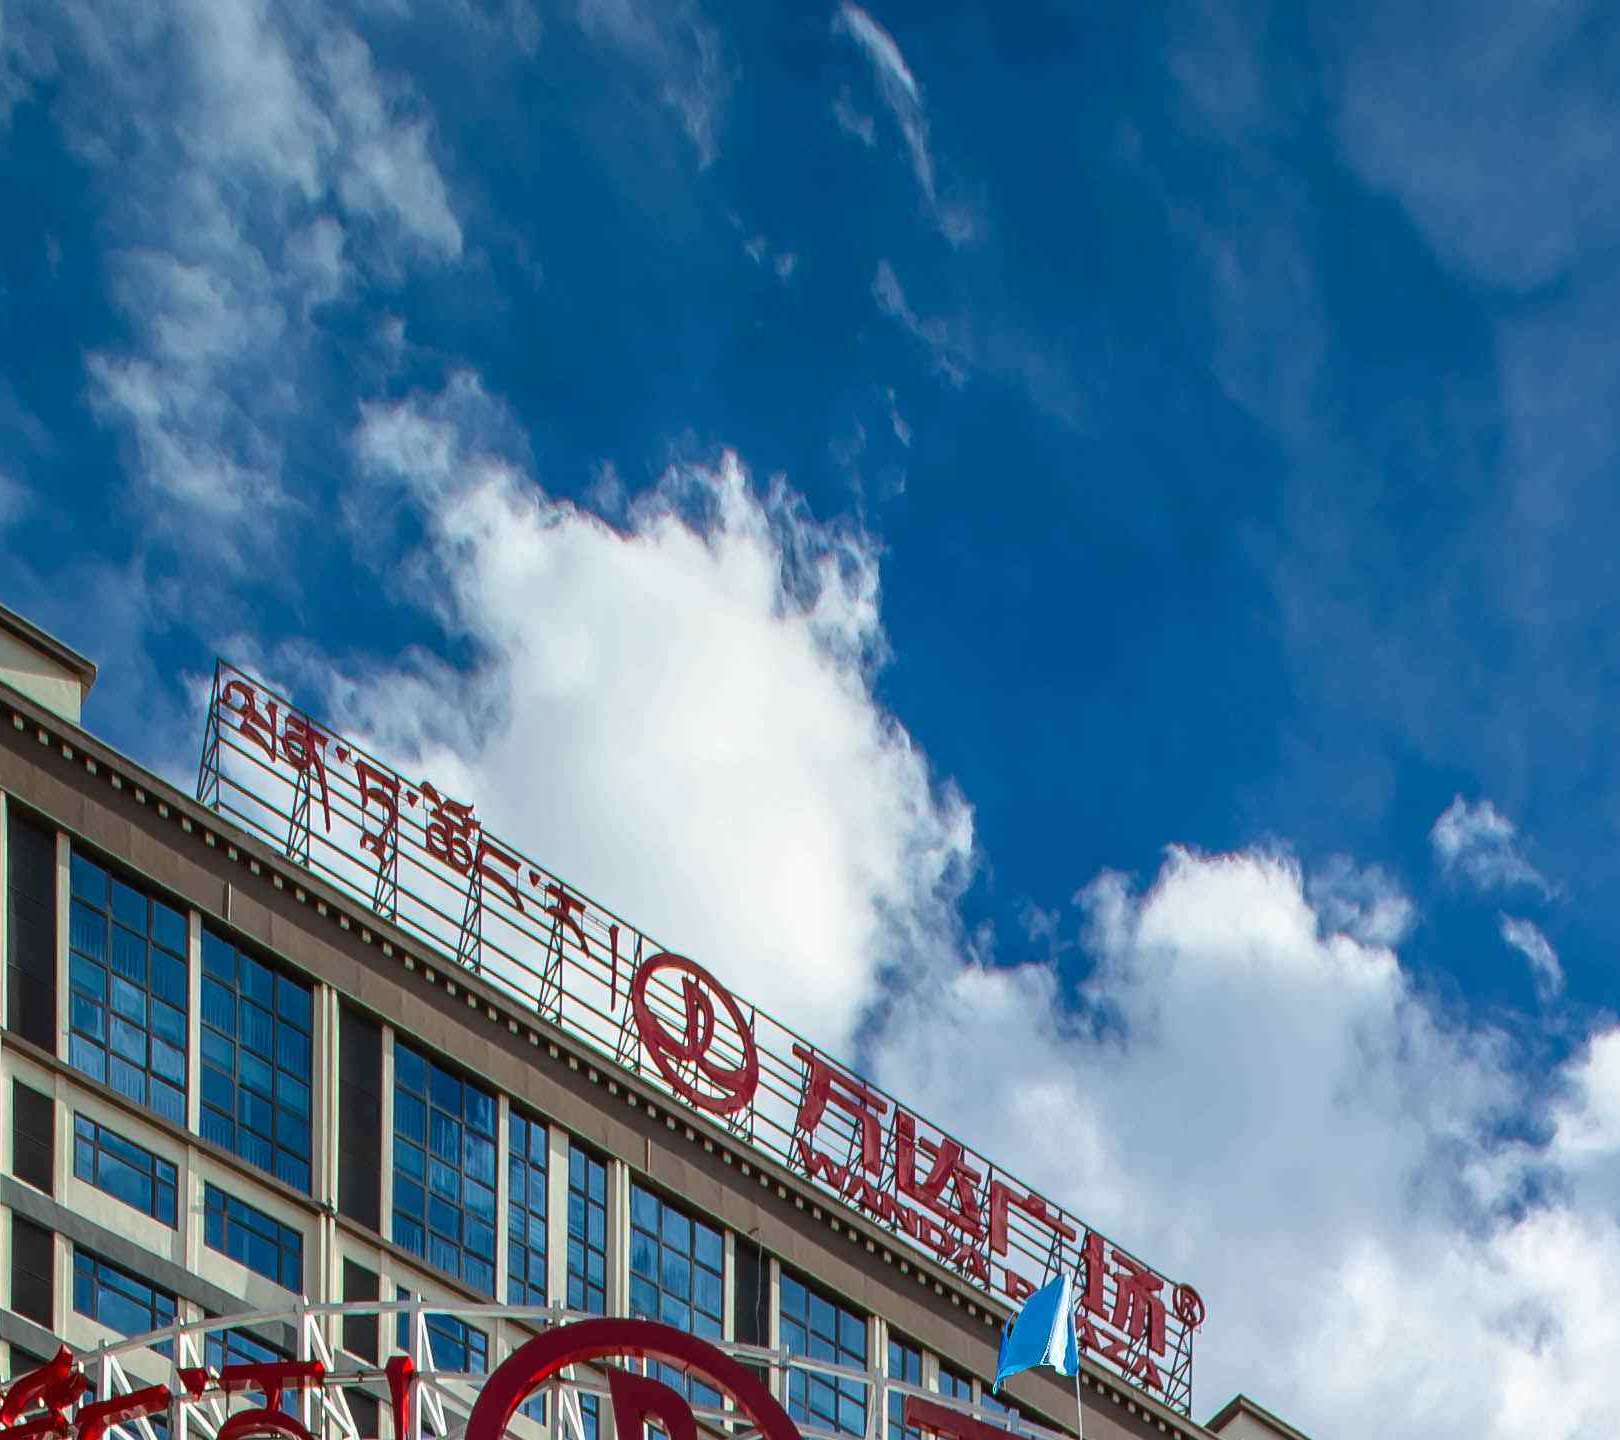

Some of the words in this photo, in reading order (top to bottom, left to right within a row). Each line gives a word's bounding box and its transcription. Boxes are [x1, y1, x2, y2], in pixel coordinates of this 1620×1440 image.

[792, 1043, 1166, 1358] 万达广场
[797, 1137, 990, 1285] WANDA
[1004, 1269, 1164, 1392] PAZA
